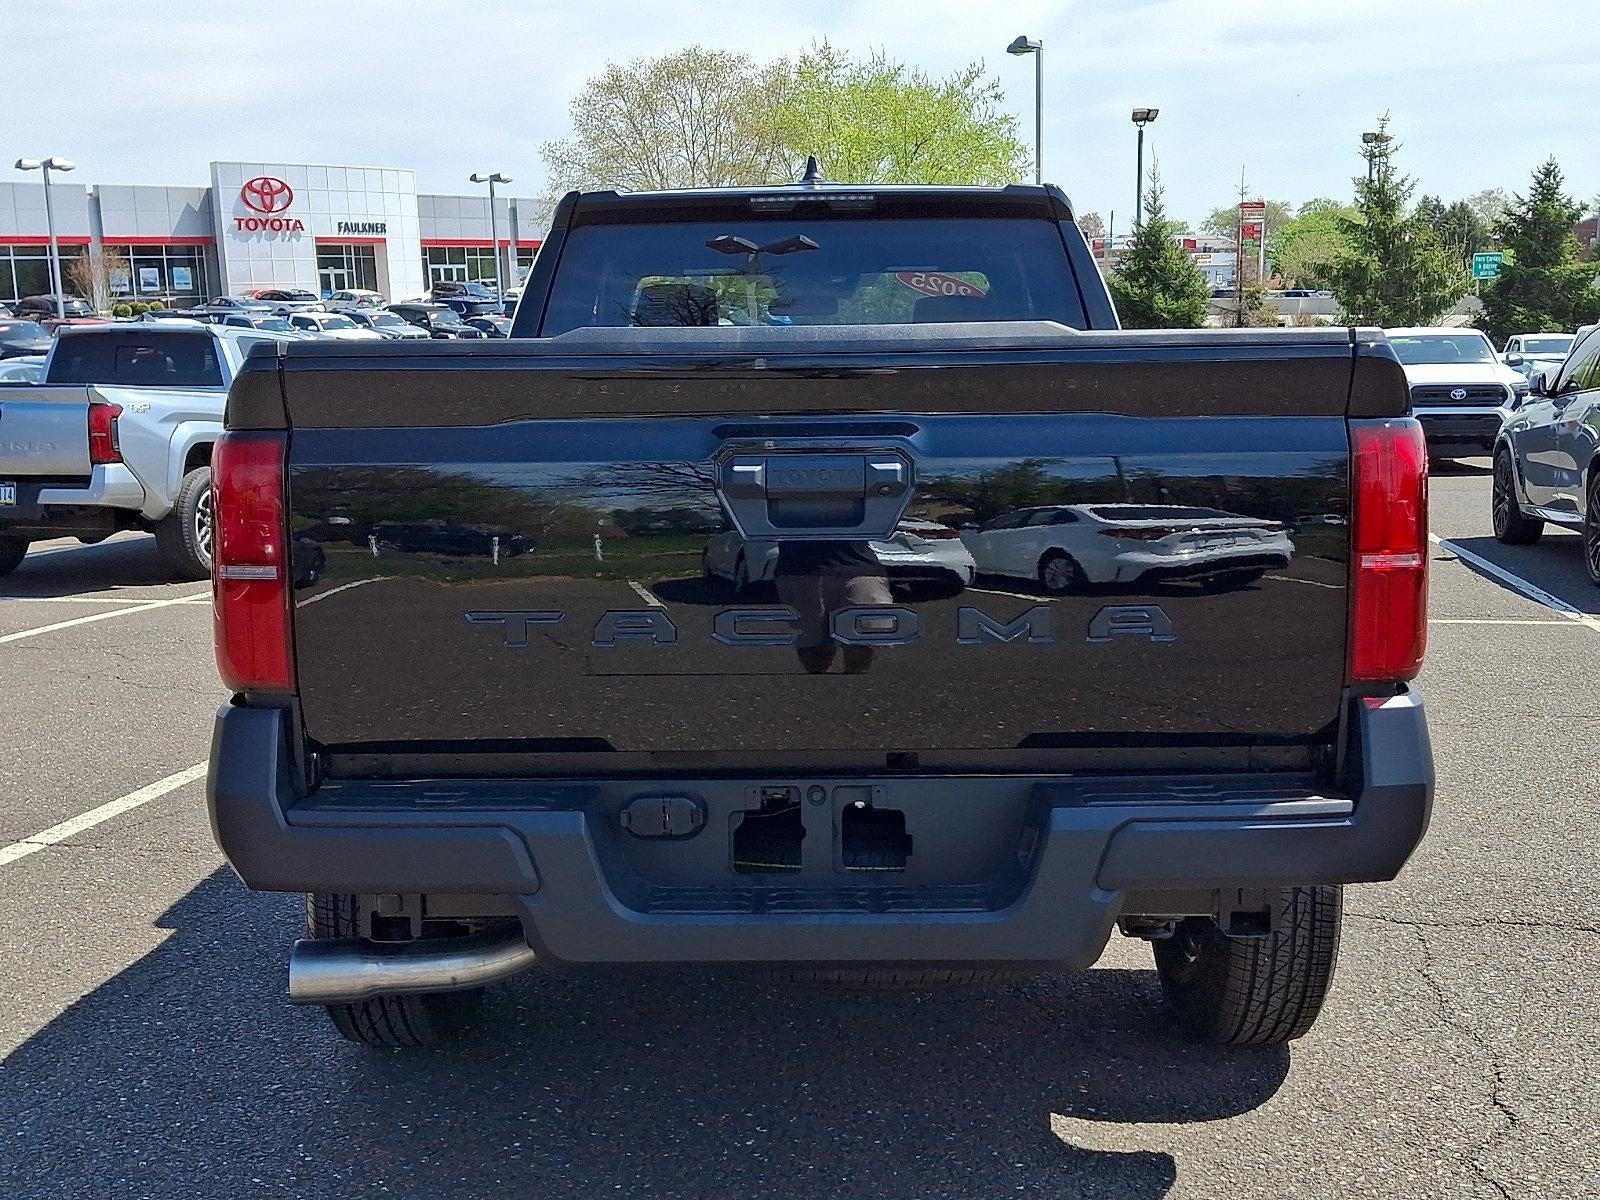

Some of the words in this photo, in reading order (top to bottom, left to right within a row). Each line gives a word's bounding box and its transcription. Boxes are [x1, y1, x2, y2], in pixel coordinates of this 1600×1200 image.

[234, 217, 305, 232] TOYOTA
[337, 221, 387, 234] FAULKNER
[772, 469, 860, 485] TOYOTA
[464, 604, 1177, 646] TACOMA
